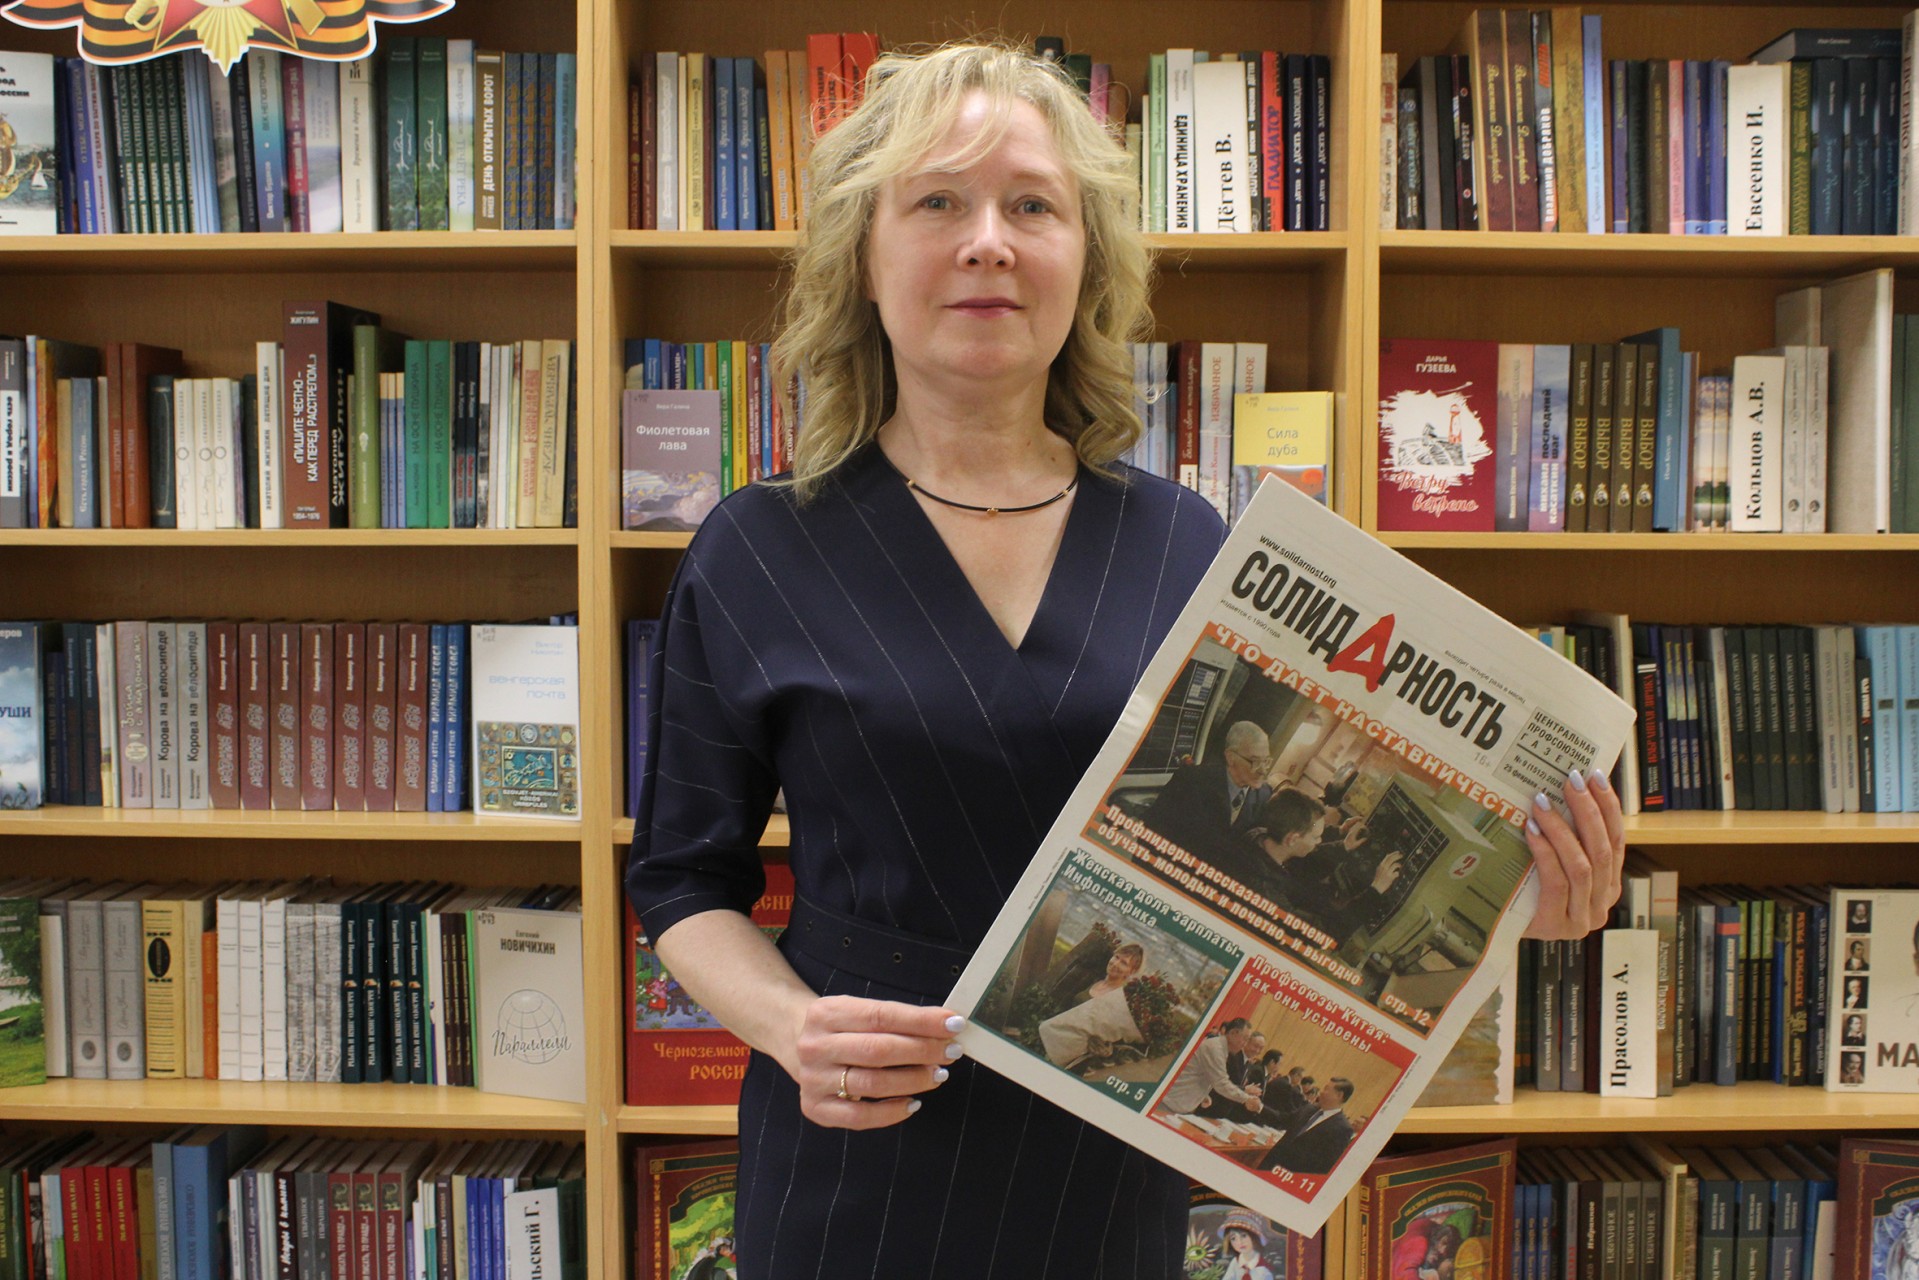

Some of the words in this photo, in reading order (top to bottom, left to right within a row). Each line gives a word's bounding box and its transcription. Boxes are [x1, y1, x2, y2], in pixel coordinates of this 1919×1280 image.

[484, 74, 494, 105] ВОРОТ
[484, 107, 494, 163] ОТКРЫТЫХ
[1540, 108, 1553, 165] ДОБРЯКОВ
[1746, 105, 1764, 128] И.
[1174, 115, 1188, 166] ЕДИНИЦА
[1215, 133, 1232, 154] В.
[1267, 105, 1280, 190] ГЛАДИАТОР
[1293, 132, 1302, 164] ДЕСЯТЬ
[483, 164, 495, 191] ДЕНЬ
[1217, 161, 1236, 232] Дёгтев
[1543, 167, 1555, 222] Владимир
[1745, 135, 1764, 232] Евсеенко
[1176, 170, 1188, 228] ХРАНЕНИЯ
[1246, 356, 1255, 394] АННОЕ
[1416, 363, 1457, 373] ГУЗЕЕВА
[1425, 355, 1448, 363] ДАРЬЯ
[293, 379, 304, 416] ЧЕСТНО
[1211, 356, 1222, 422] ИЗБРАННОЕ
[1748, 381, 1765, 424] А.В.
[294, 418, 305, 463] «ПИШИТЕ
[636, 425, 710, 436] Фиолетовая
[1267, 427, 1298, 439] Сила
[1542, 388, 1552, 459] последний
[1573, 417, 1588, 469] ВЫБОР
[1596, 417, 1611, 469] ВЫБОР
[1619, 418, 1633, 469] ВЫБОР
[1640, 418, 1654, 469] ВЫБОР
[307, 430, 319, 460] ПЕРЕД
[542, 427, 553, 475] ЖИЗНЬ
[659, 441, 687, 450] лава
[1267, 445, 1298, 458] дуба
[1552, 434, 1560, 459] шаг
[307, 461, 319, 482] КАК
[1539, 462, 1549, 512] михаил
[1746, 431, 1763, 521] Кольцов
[1549, 462, 1558, 524] касаткин
[1257, 531, 1338, 590] www.solidarnost.org
[1250, 616, 1267, 630] 1990
[156, 630, 168, 697] велосипеде
[188, 630, 199, 698] велосипеде
[1231, 550, 1507, 751] СОЛИДАРНОСТЬ
[157, 703, 168, 716] на
[187, 703, 198, 716] на
[526, 690, 566, 700] почта
[158, 720, 171, 761] Корова
[187, 721, 201, 762] Корова
[1210, 621, 1265, 666] ЧТО
[1260, 654, 1333, 713] ДАЕТ
[1332, 695, 1530, 834] НАСТАВНИЧЕСТВ
[1525, 721, 1592, 767] ПРОФСОЮЗНАЯ
[1532, 710, 1598, 756] ЦЕНТРАЛЬНАЯ
[1470, 749, 1495, 771] 16+
[1502, 763, 1513, 773] 25
[1509, 767, 1539, 790] февраля
[1059, 862, 1160, 932] Инфографика
[1102, 803, 1199, 871] Профлидеры
[1193, 860, 1284, 923] рассказали,
[1280, 911, 1335, 953] почему
[1069, 846, 1137, 895] Женская
[1132, 886, 1172, 918] доля
[1169, 907, 1245, 961] зарплаты.
[1093, 820, 1154, 866] обучать
[1151, 854, 1219, 903] молодых
[1215, 893, 1231, 909] и
[1226, 899, 1291, 947] почетно,
[1288, 936, 1304, 952] и
[1300, 943, 1363, 989] выгодно
[501, 938, 556, 955] НОВИЧИХИН
[1611, 963, 1629, 984] А.
[1241, 969, 1272, 995] как
[1272, 986, 1303, 1012] они
[1299, 1004, 1374, 1058] устроены
[1249, 953, 1341, 1018] Профсоюзы
[1340, 1006, 1392, 1046] Китая:
[1381, 991, 1413, 1018] стр.
[1410, 1006, 1432, 1028] 12
[492, 1030, 572, 1059] Параллели
[653, 1042, 751, 1061] Черноземног
[1610, 991, 1632, 1088] Прасолов
[1104, 1071, 1134, 1097] стр.
[1132, 1086, 1147, 1102] 5
[279, 1178, 288, 1218] камине
[1269, 1162, 1298, 1187] стр.
[1298, 1176, 1315, 1193] 11
[524, 1201, 540, 1217] Г.
[279, 1231, 295, 1264] Искры
